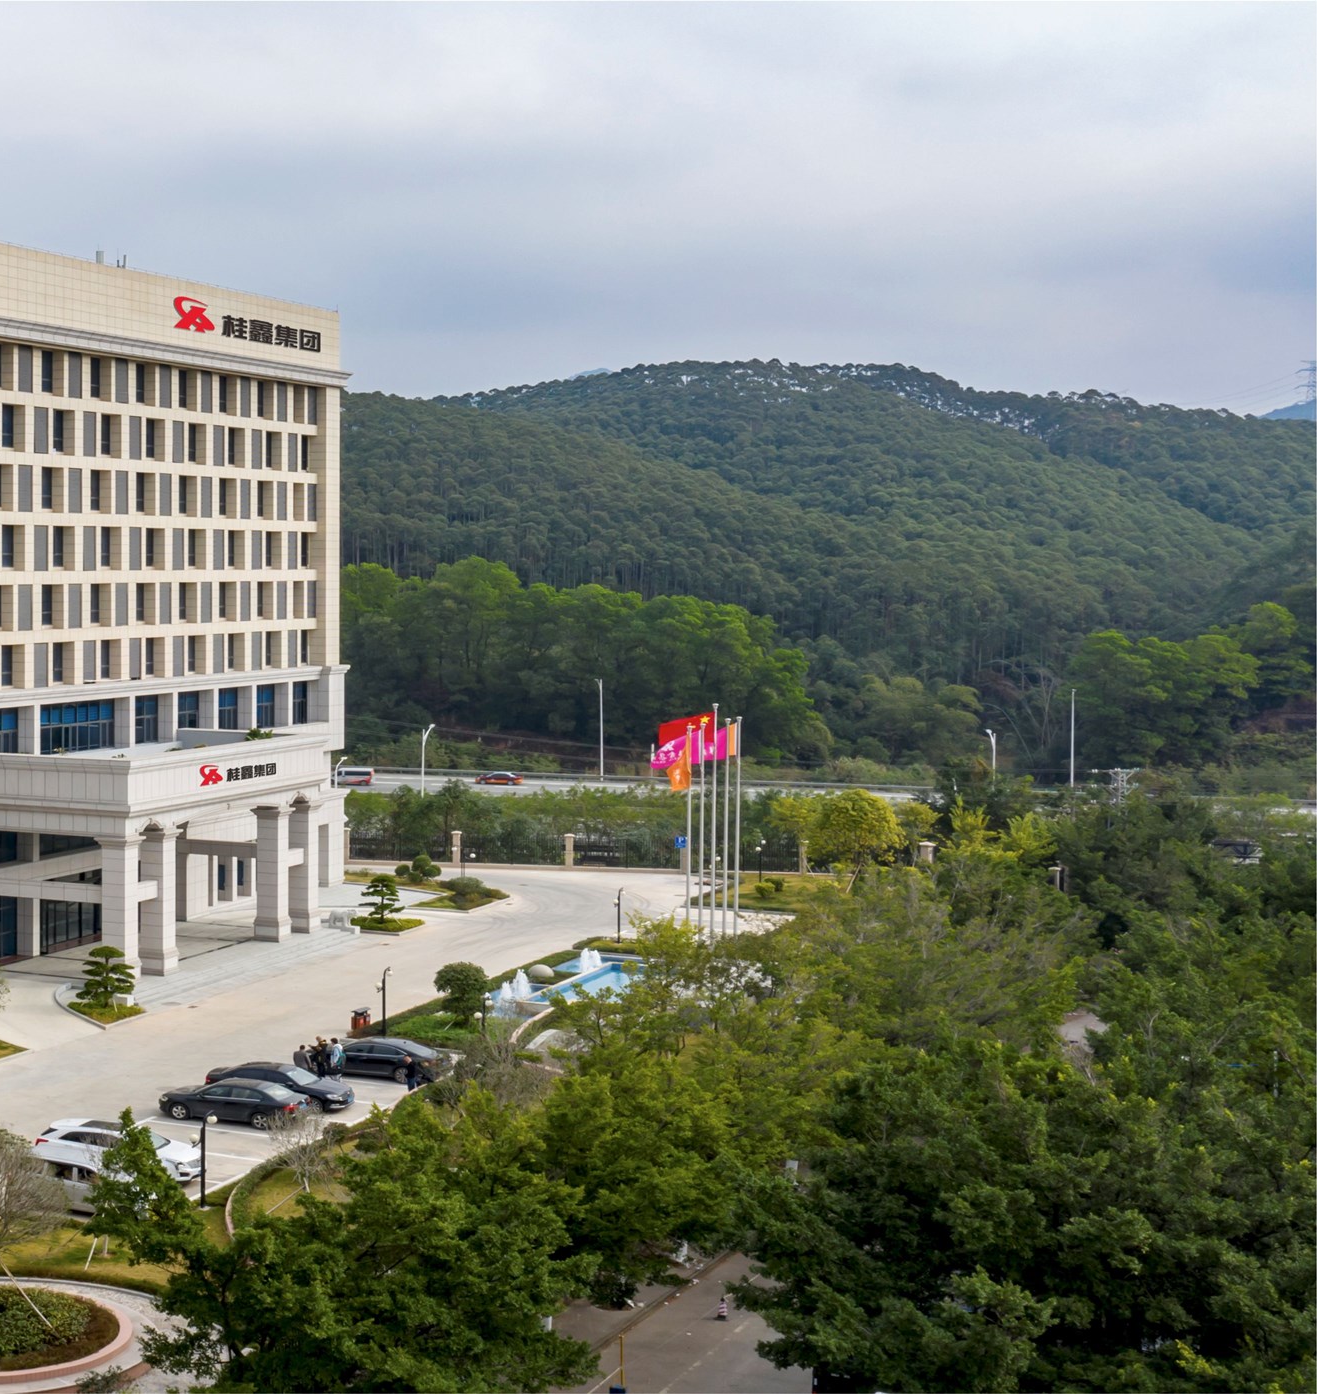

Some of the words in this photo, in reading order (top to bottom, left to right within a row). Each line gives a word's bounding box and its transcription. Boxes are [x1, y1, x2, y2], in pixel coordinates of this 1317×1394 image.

[221, 315, 321, 353] 桂鑫集团
[226, 762, 276, 782] 桂鑫集团
